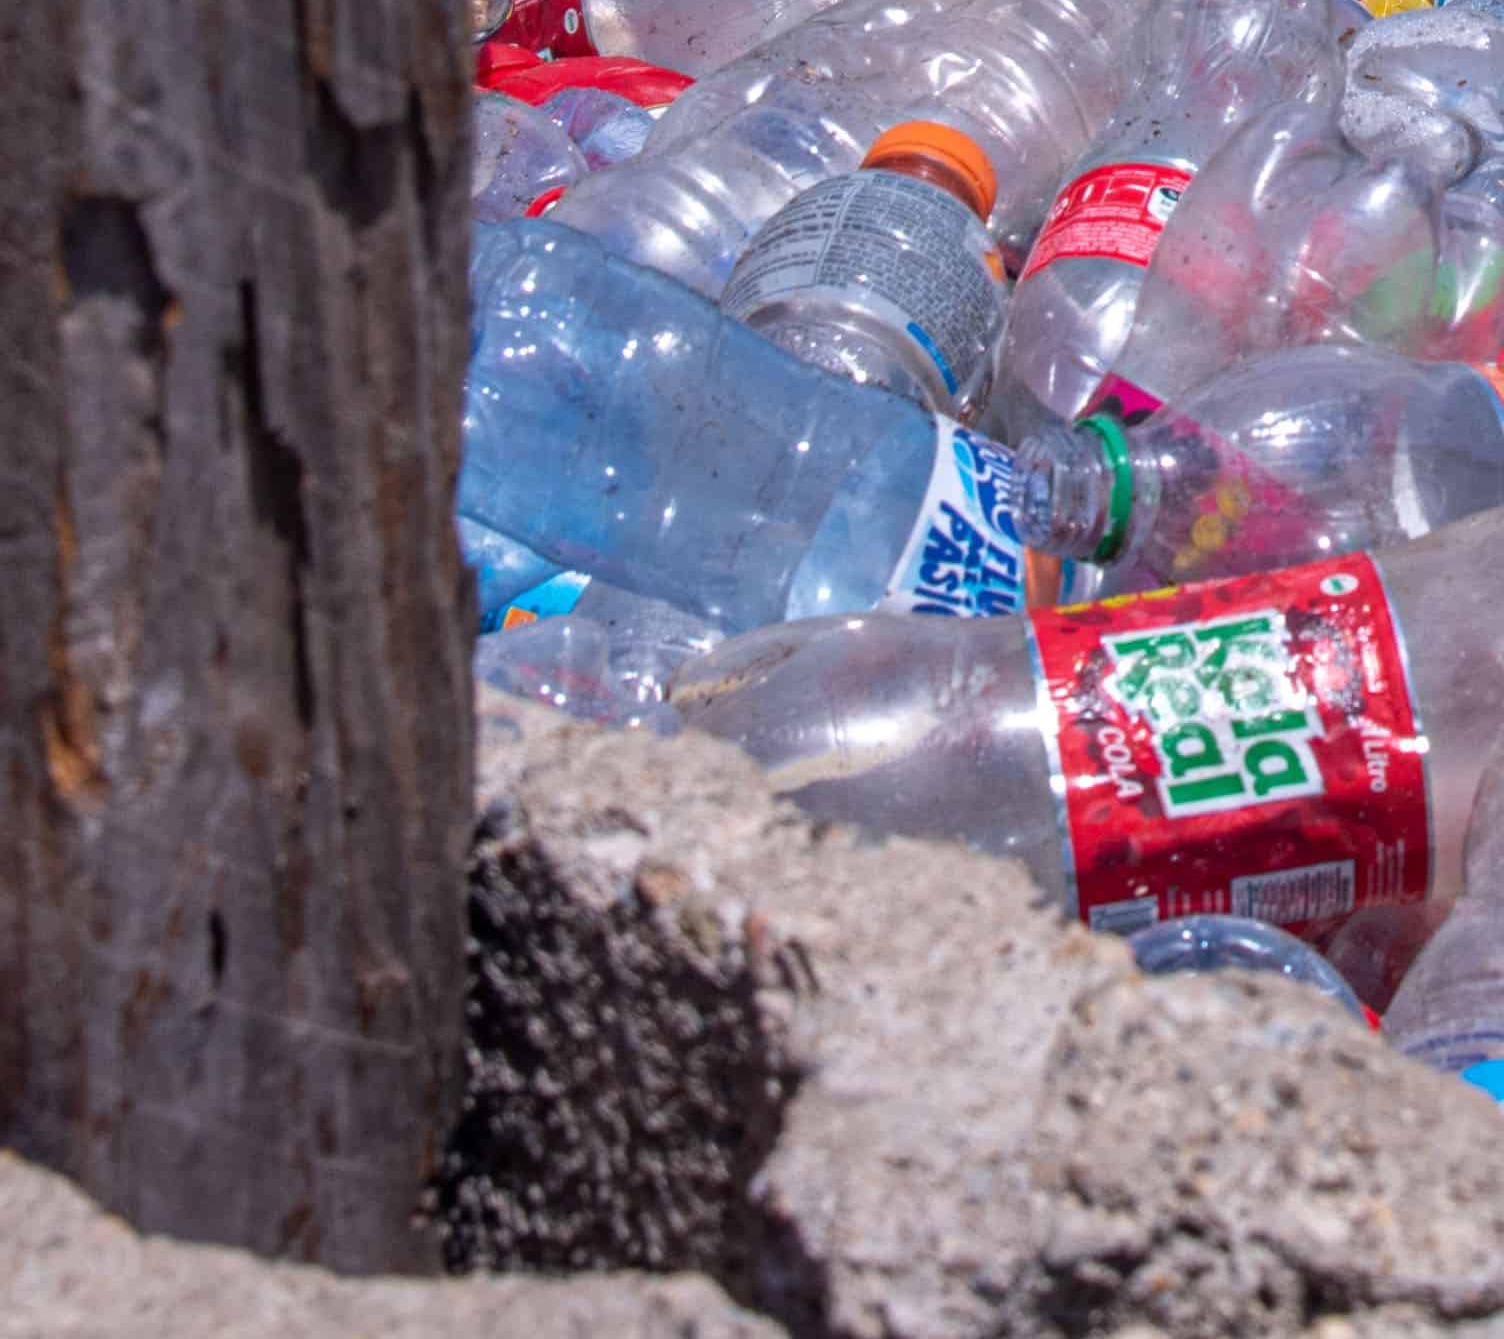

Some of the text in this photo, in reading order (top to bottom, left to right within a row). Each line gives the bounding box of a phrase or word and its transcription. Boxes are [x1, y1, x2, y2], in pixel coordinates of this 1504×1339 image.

[1096, 727, 1143, 799] COLA
[1107, 633, 1245, 807] Real
[1193, 617, 1308, 796] Kola
[1363, 736, 1389, 794] Litro
